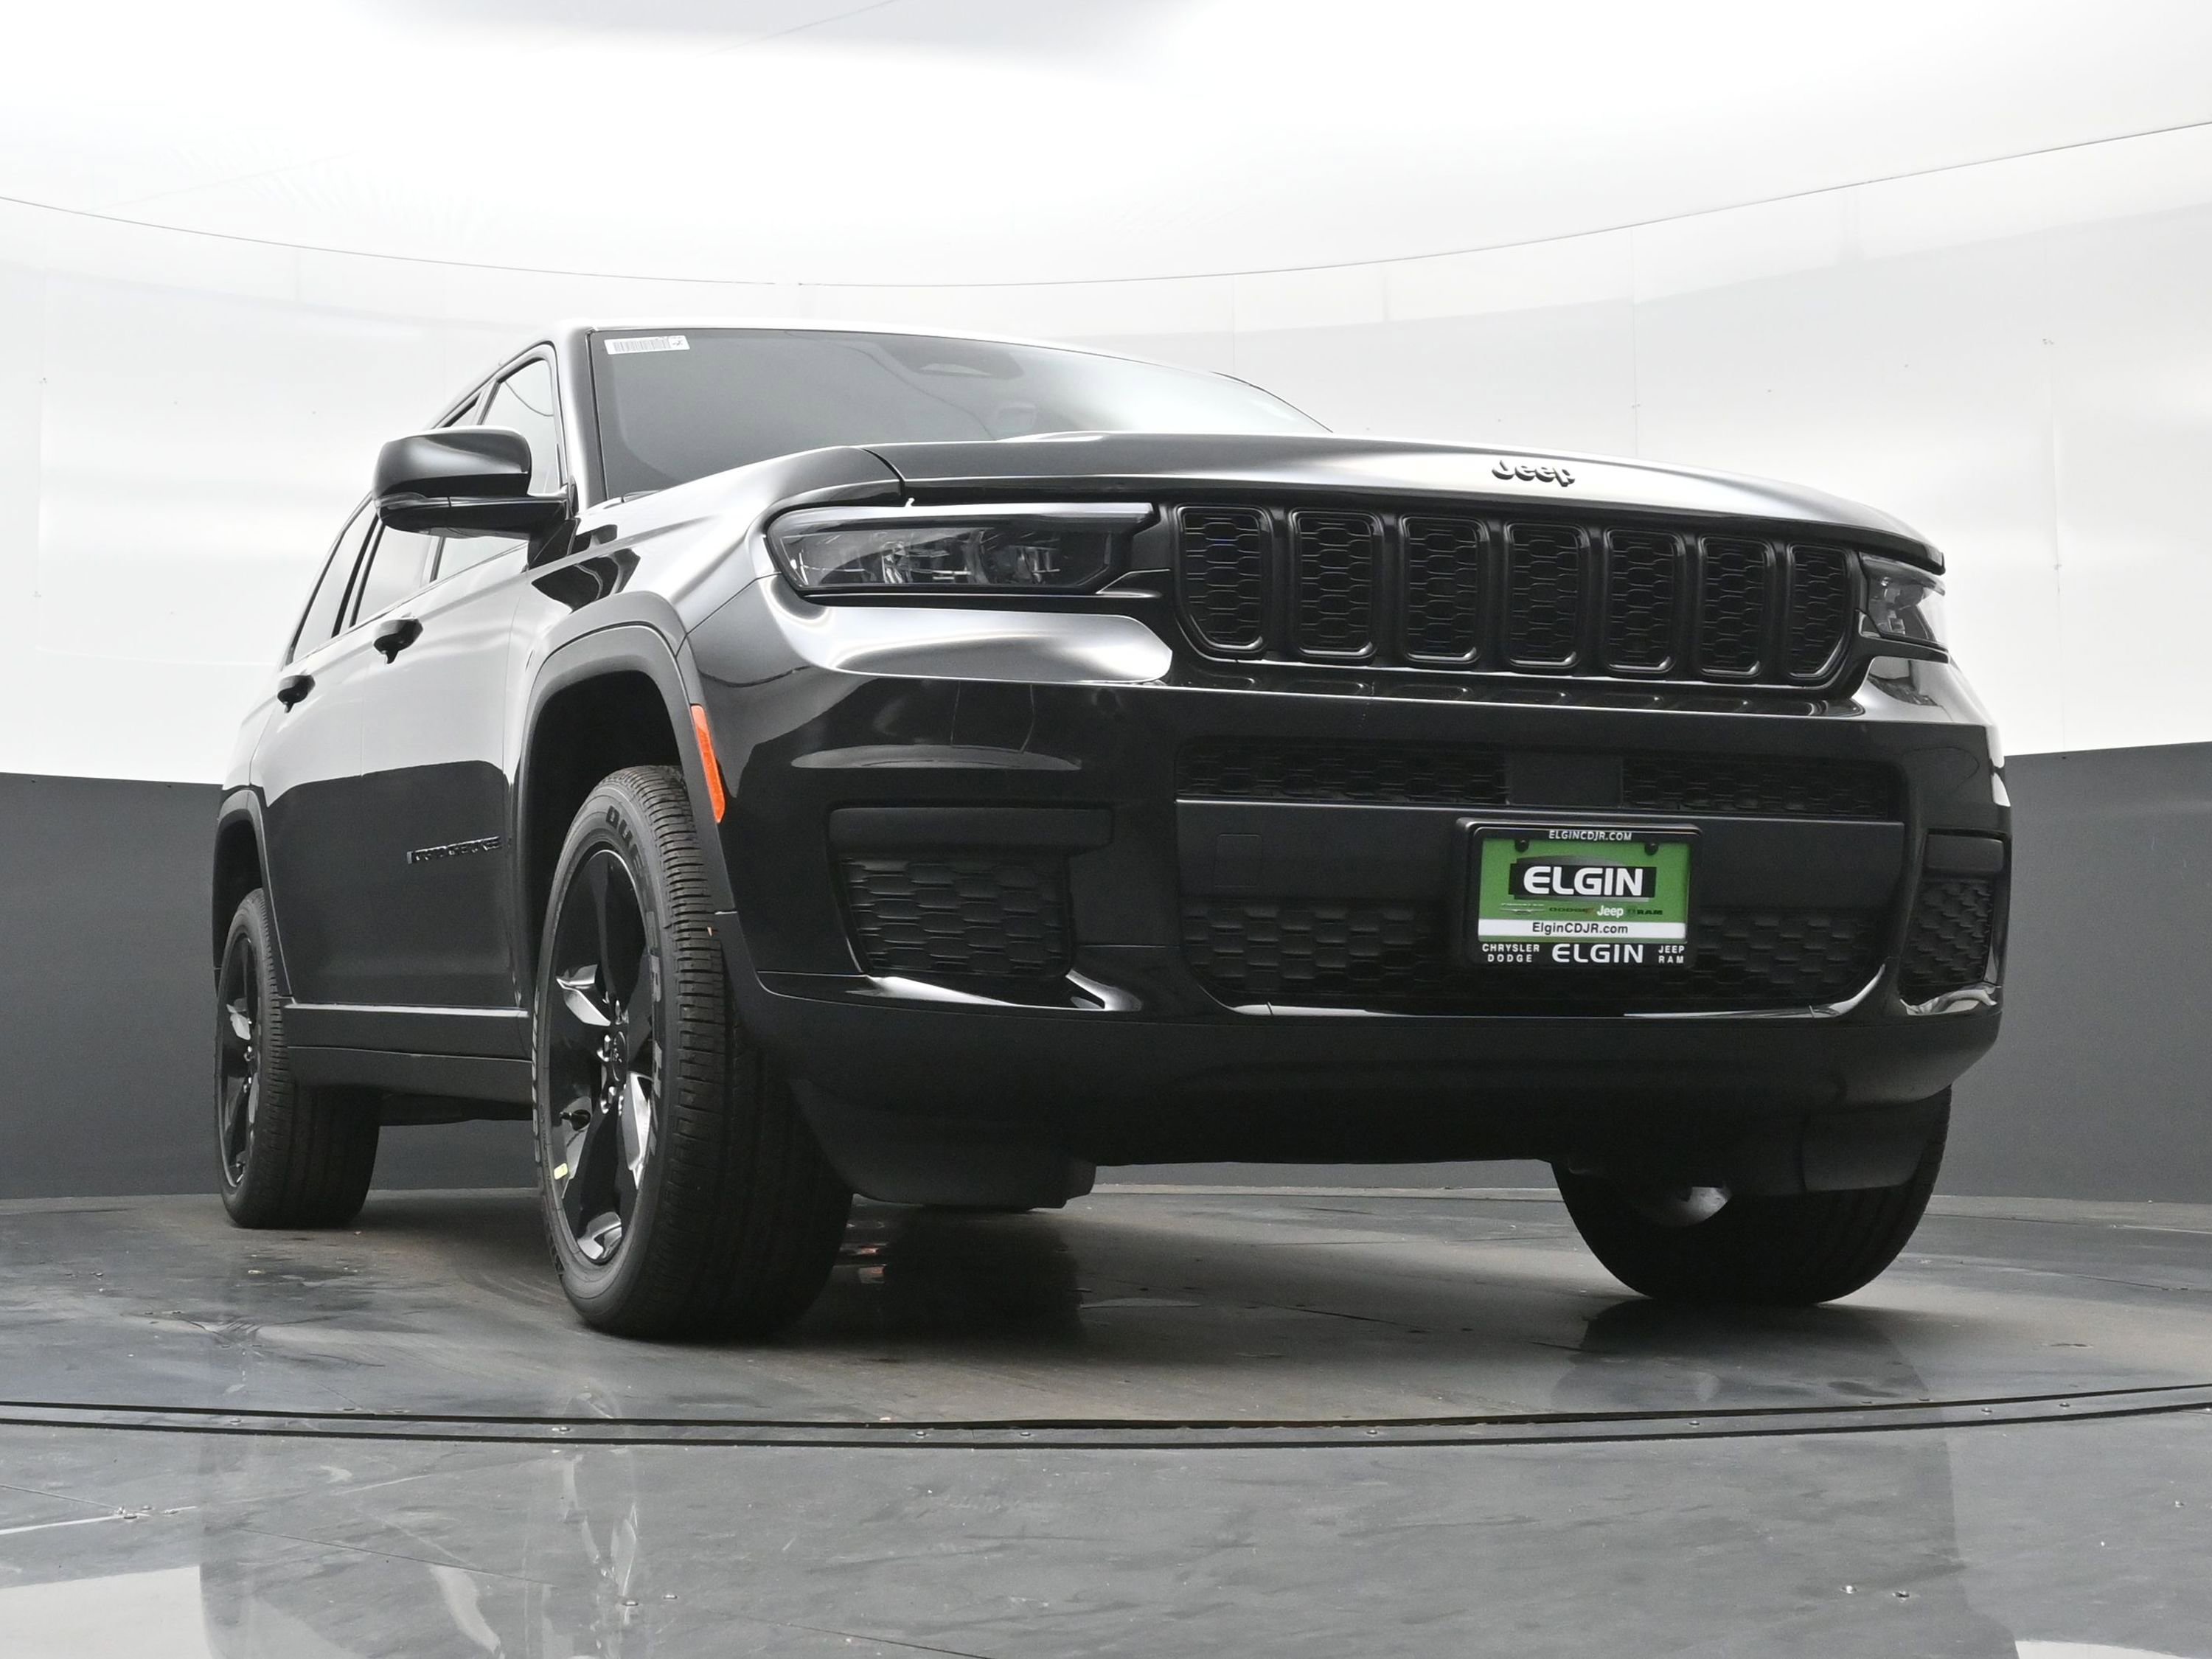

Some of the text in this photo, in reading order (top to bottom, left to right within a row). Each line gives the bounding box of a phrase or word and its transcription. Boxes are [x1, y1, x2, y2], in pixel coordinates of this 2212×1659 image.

[1491, 459, 1576, 487] Jeep
[1548, 830, 1632, 841] ELGINCDJR.COM
[1523, 866, 1644, 896] ELGIN
[1596, 905, 1624, 918] Jeep
[1532, 922, 1628, 935] ElginCDJR.com
[1482, 943, 1686, 964] CHRYSLER ELGIN JEEP
[1487, 954, 1685, 964] DODGE RAM
